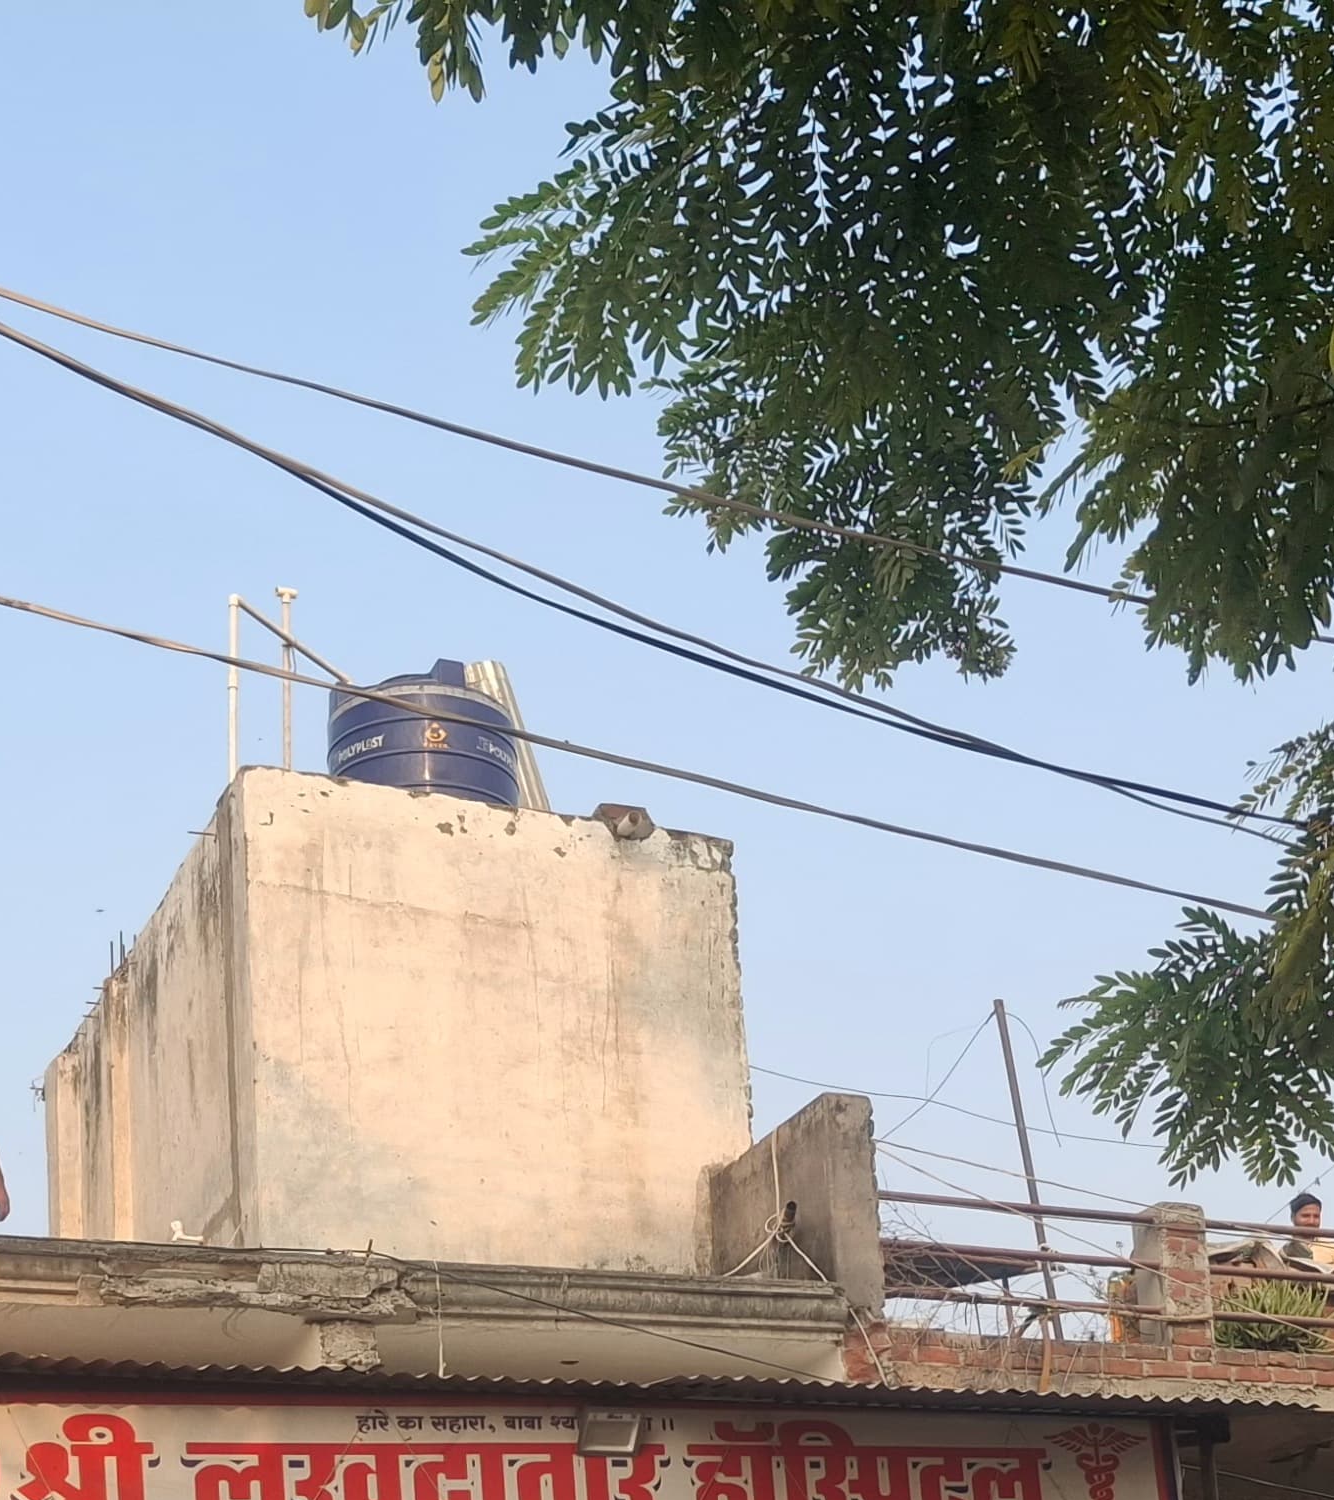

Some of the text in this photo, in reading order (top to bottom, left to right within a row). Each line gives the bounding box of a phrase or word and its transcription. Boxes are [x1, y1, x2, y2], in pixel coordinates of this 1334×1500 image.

[356, 1409, 390, 1433] हारे
[396, 1415, 423, 1431] का
[503, 1415, 543, 1431] बाबा
